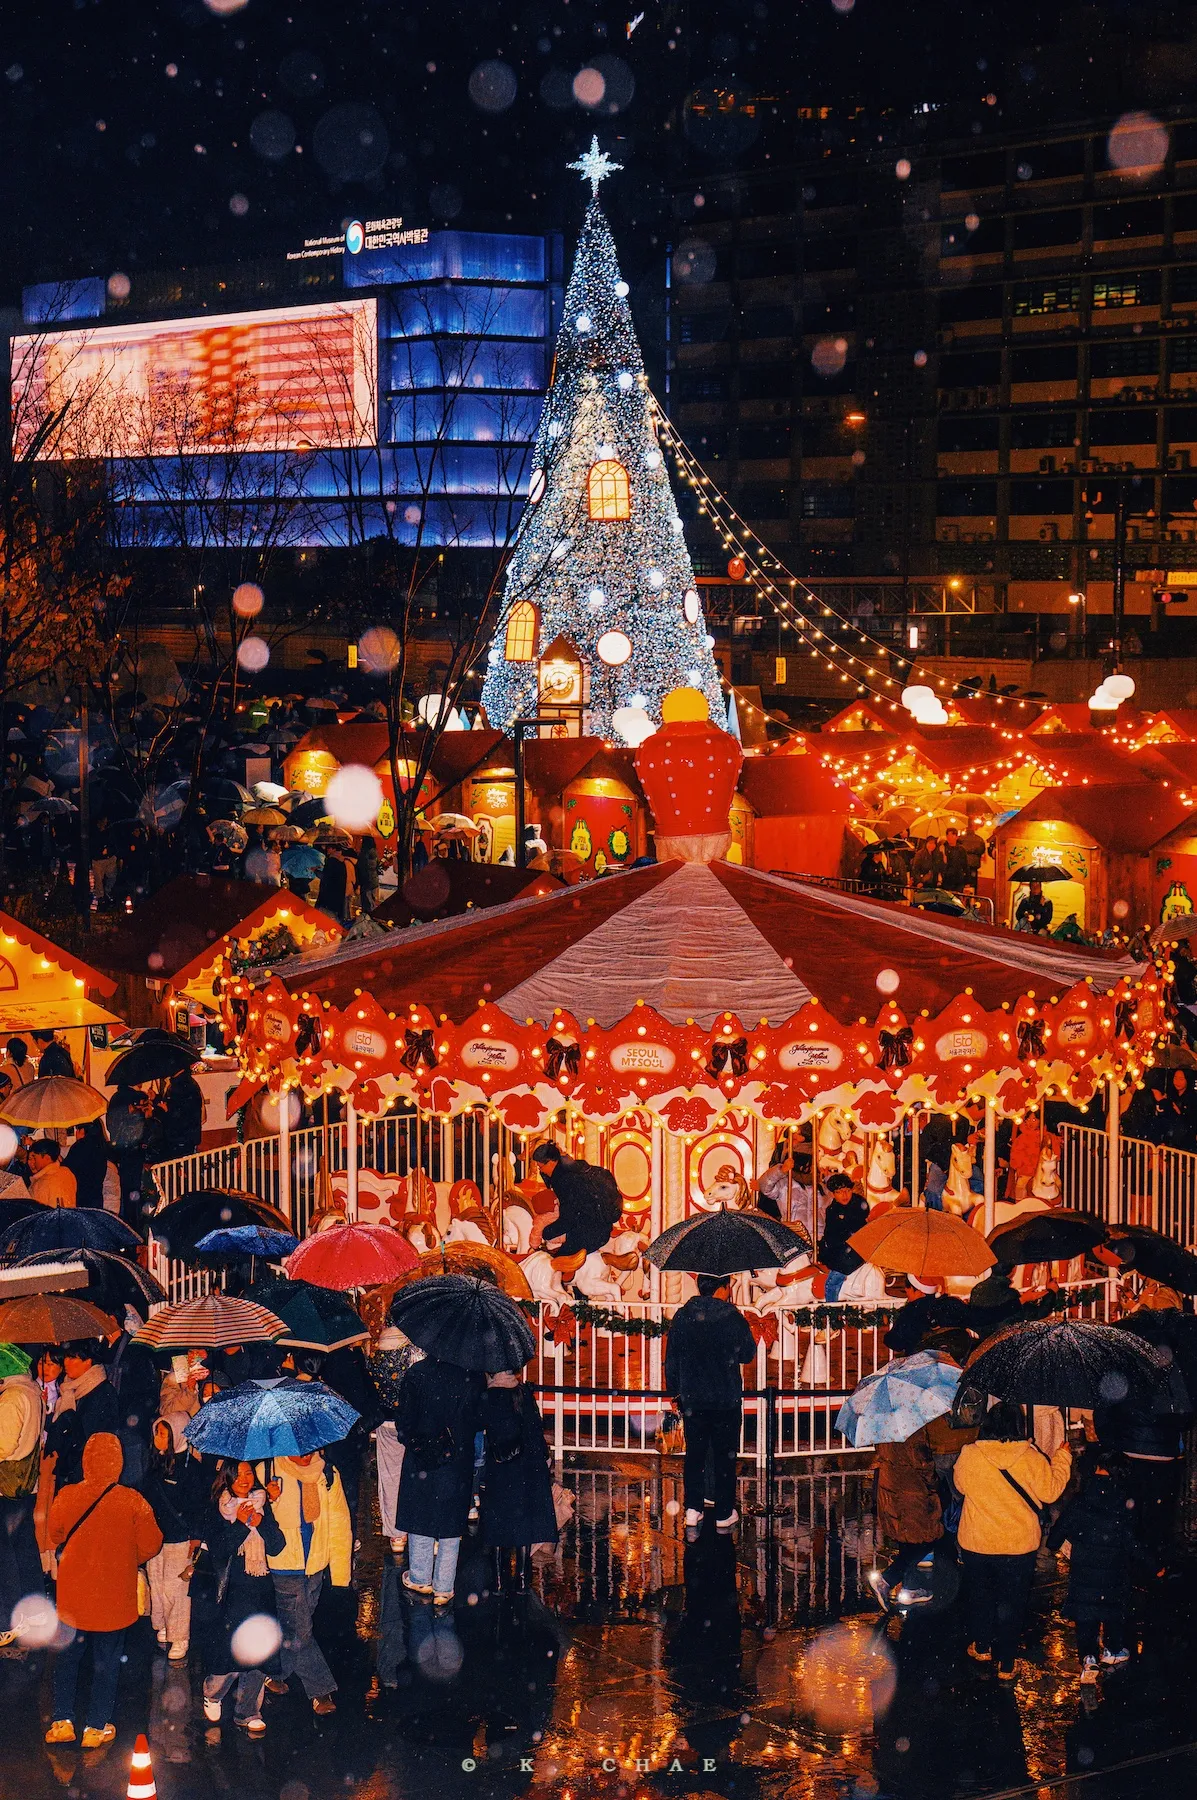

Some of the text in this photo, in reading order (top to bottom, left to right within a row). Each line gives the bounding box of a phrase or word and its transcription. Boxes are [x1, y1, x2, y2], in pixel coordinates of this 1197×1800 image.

[365, 217, 402, 233] 문화체육관광부
[365, 228, 428, 249] 대한민국역사박물관
[626, 1048, 659, 1058] SEOUL
